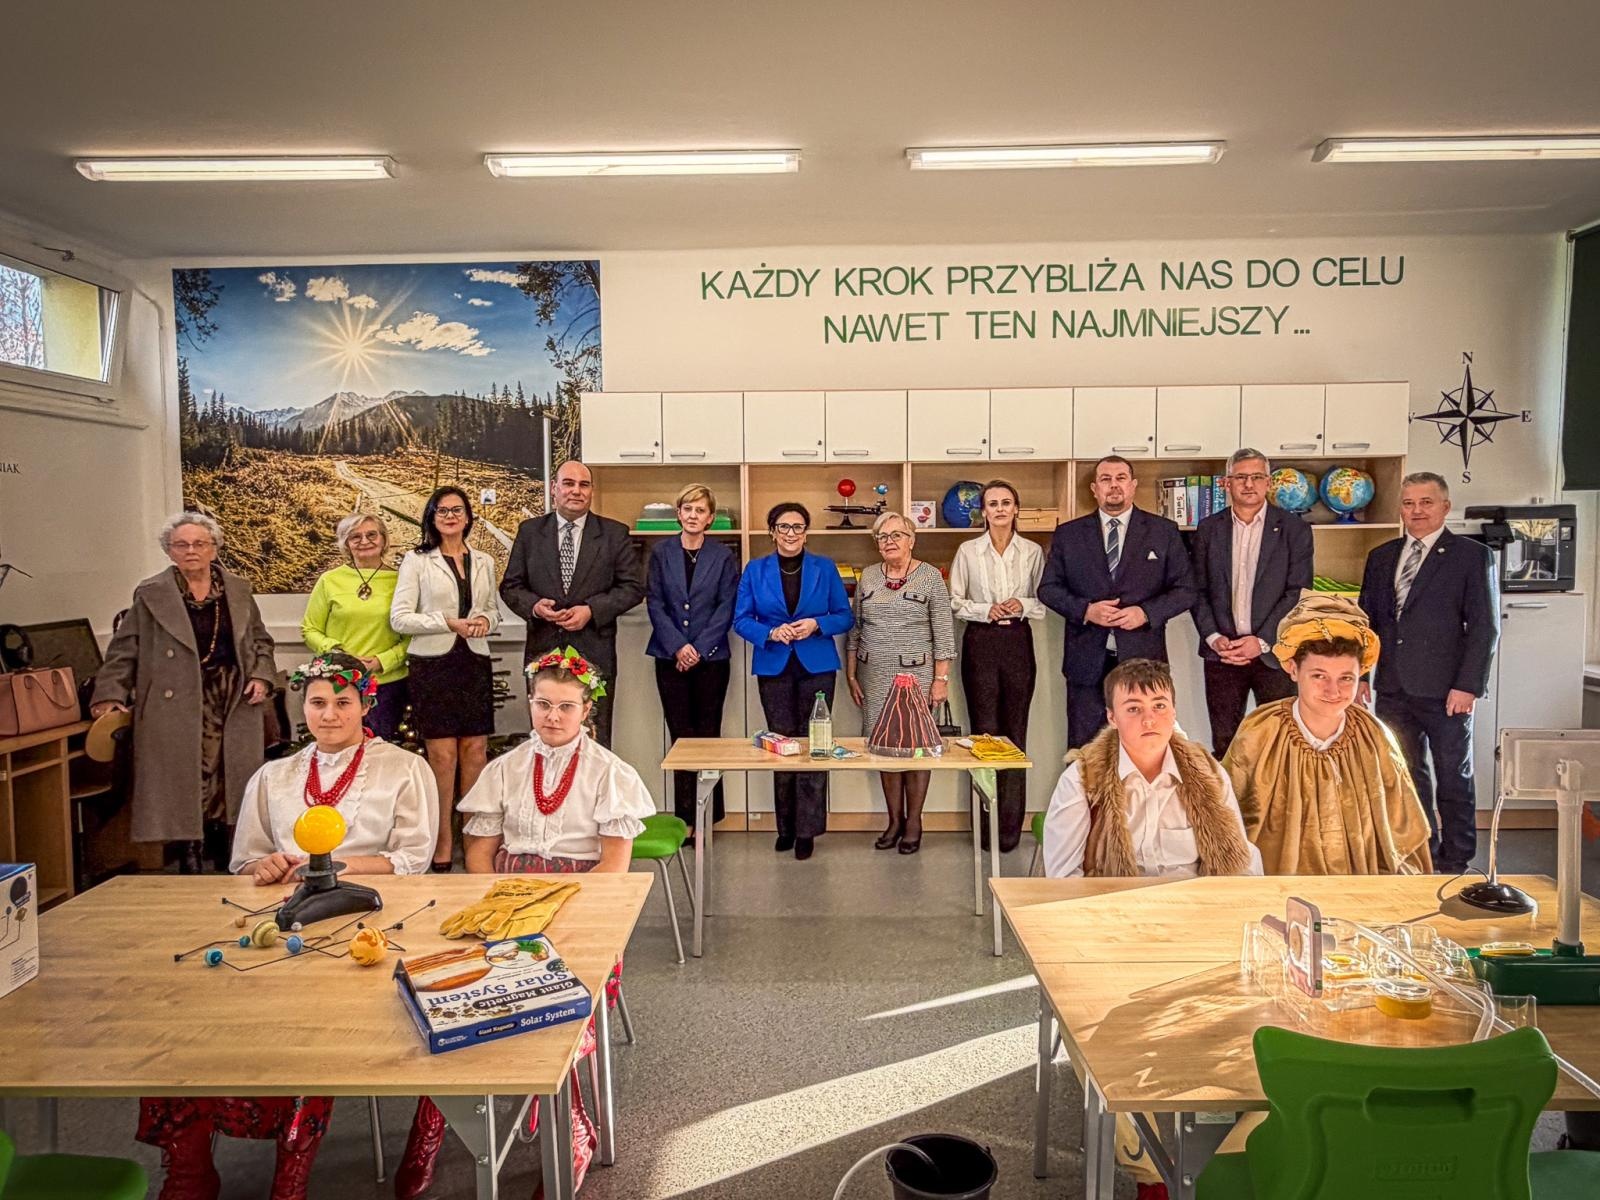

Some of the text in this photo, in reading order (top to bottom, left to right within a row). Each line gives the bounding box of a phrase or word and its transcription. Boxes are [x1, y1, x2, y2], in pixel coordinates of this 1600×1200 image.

[702, 256, 1404, 300] KAŻDY KROK PRZYBLIŻA NAS DO CELU
[824, 312, 949, 344] NAWET
[966, 311, 1035, 339] TEN
[1462, 352, 1473, 364] N
[1521, 410, 1532, 422] E
[1462, 471, 1472, 484] S
[515, 971, 568, 988] Solar
[540, 981, 574, 994] Giant
[427, 984, 508, 1008] System
[479, 990, 538, 1008] Magnetic
[520, 1008, 576, 1027] Solar System
